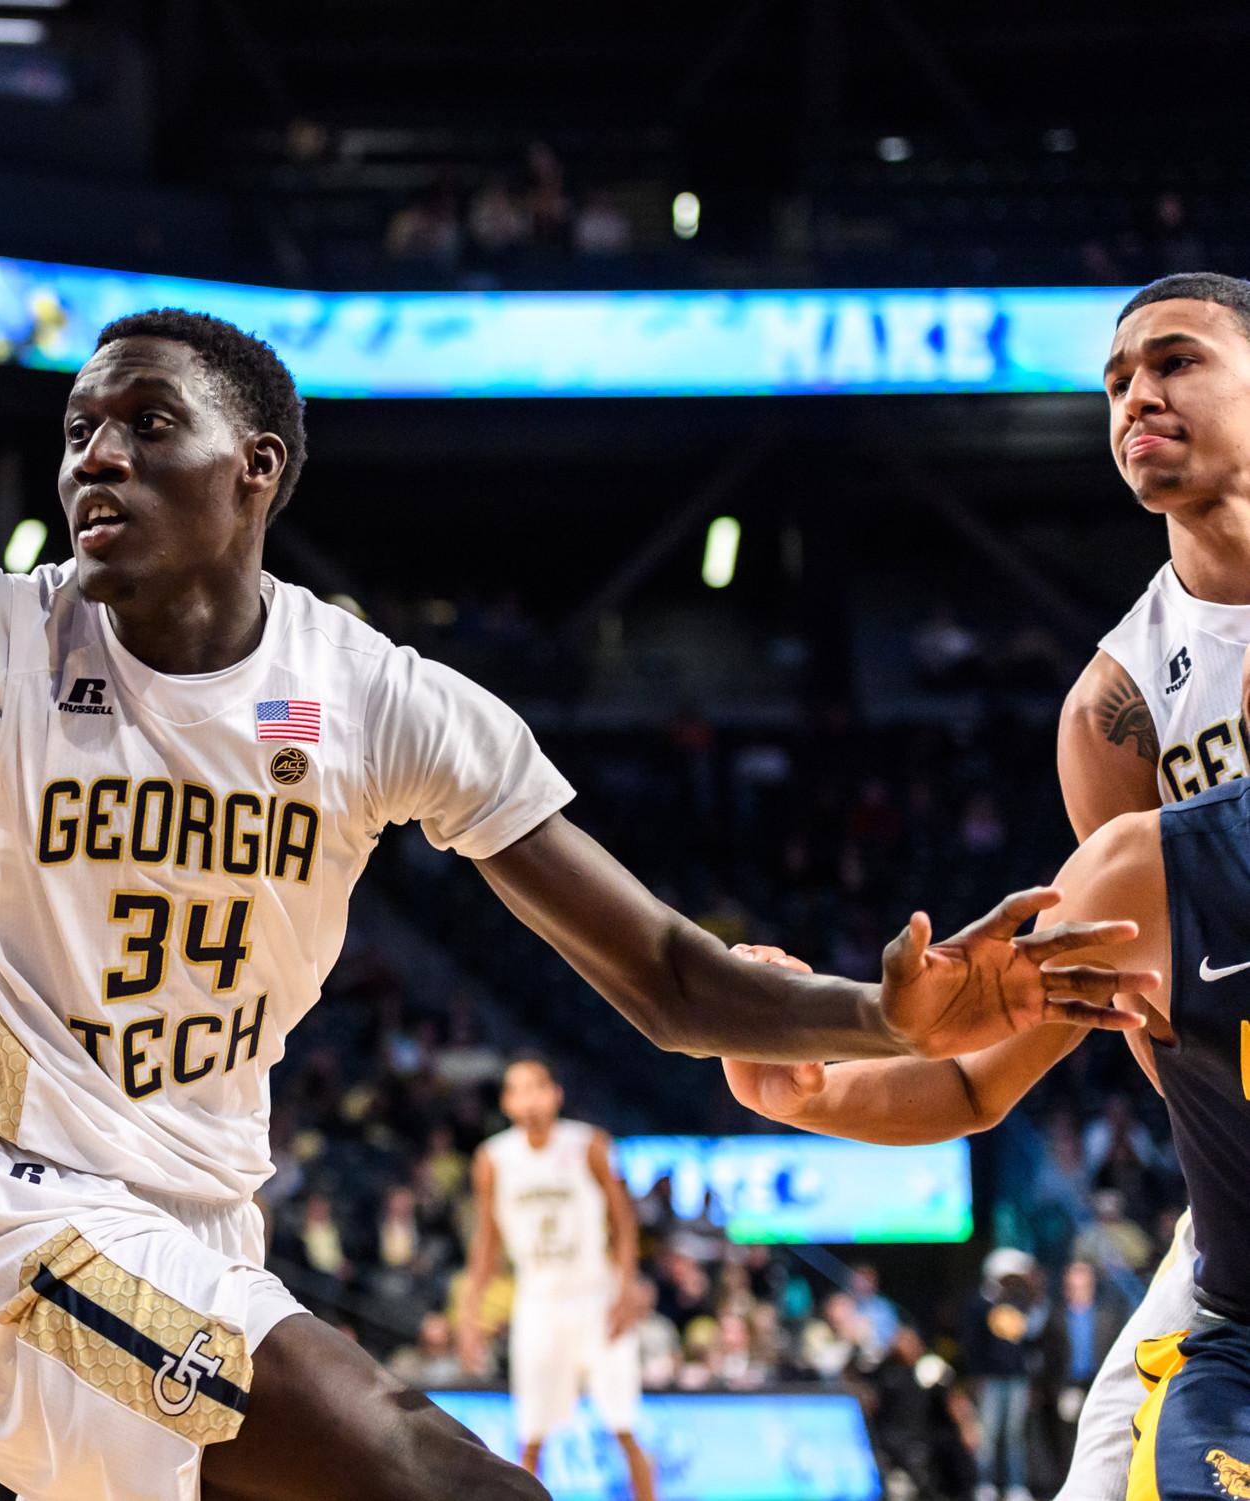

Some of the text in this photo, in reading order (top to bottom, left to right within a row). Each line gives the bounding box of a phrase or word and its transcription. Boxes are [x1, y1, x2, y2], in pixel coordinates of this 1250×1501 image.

[762, 296, 995, 382] MAKE
[58, 702, 114, 715] RUSSELL
[276, 760, 306, 769] ACC
[37, 776, 322, 886] GEORGIA
[102, 889, 255, 1006] 34
[67, 990, 269, 1102] TECH
